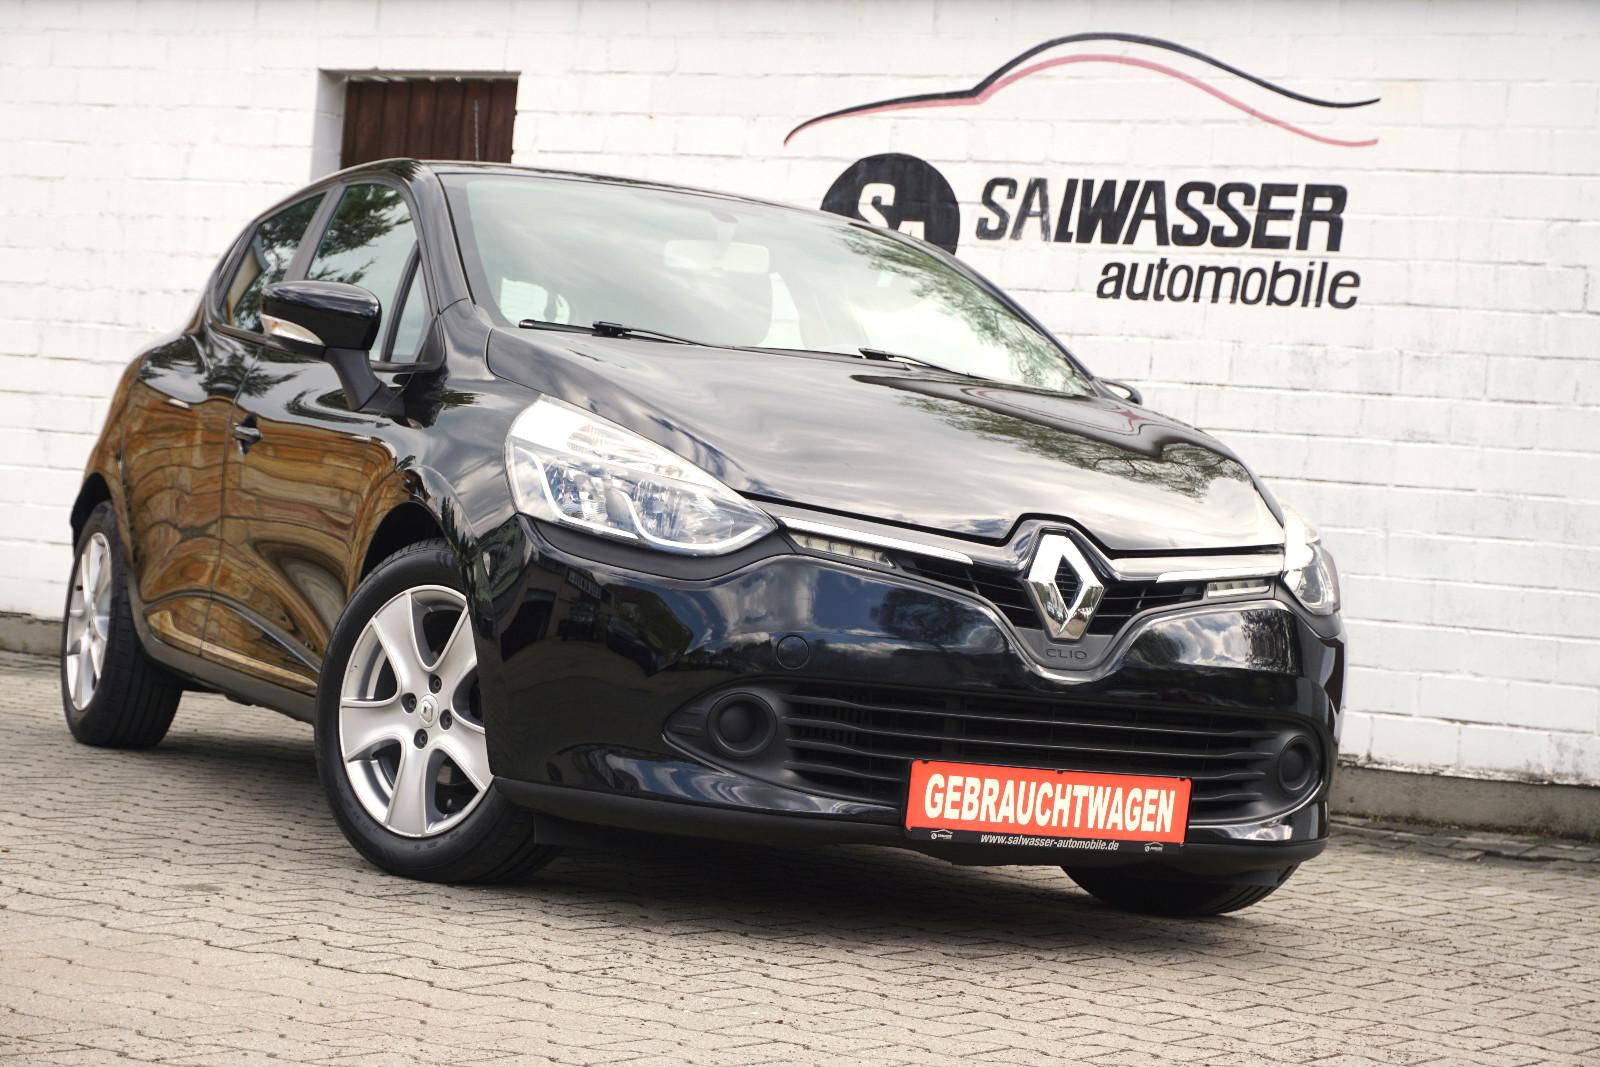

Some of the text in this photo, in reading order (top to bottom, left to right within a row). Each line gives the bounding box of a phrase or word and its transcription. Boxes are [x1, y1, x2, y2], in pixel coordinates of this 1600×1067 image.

[975, 177, 1348, 252] SALWASSER
[1096, 257, 1361, 310] automobile
[1046, 648, 1088, 660] CLIO
[923, 773, 1176, 833] GEBRAUCHTWAGEN
[980, 832, 1120, 851] www.salwasser-automobile.de
